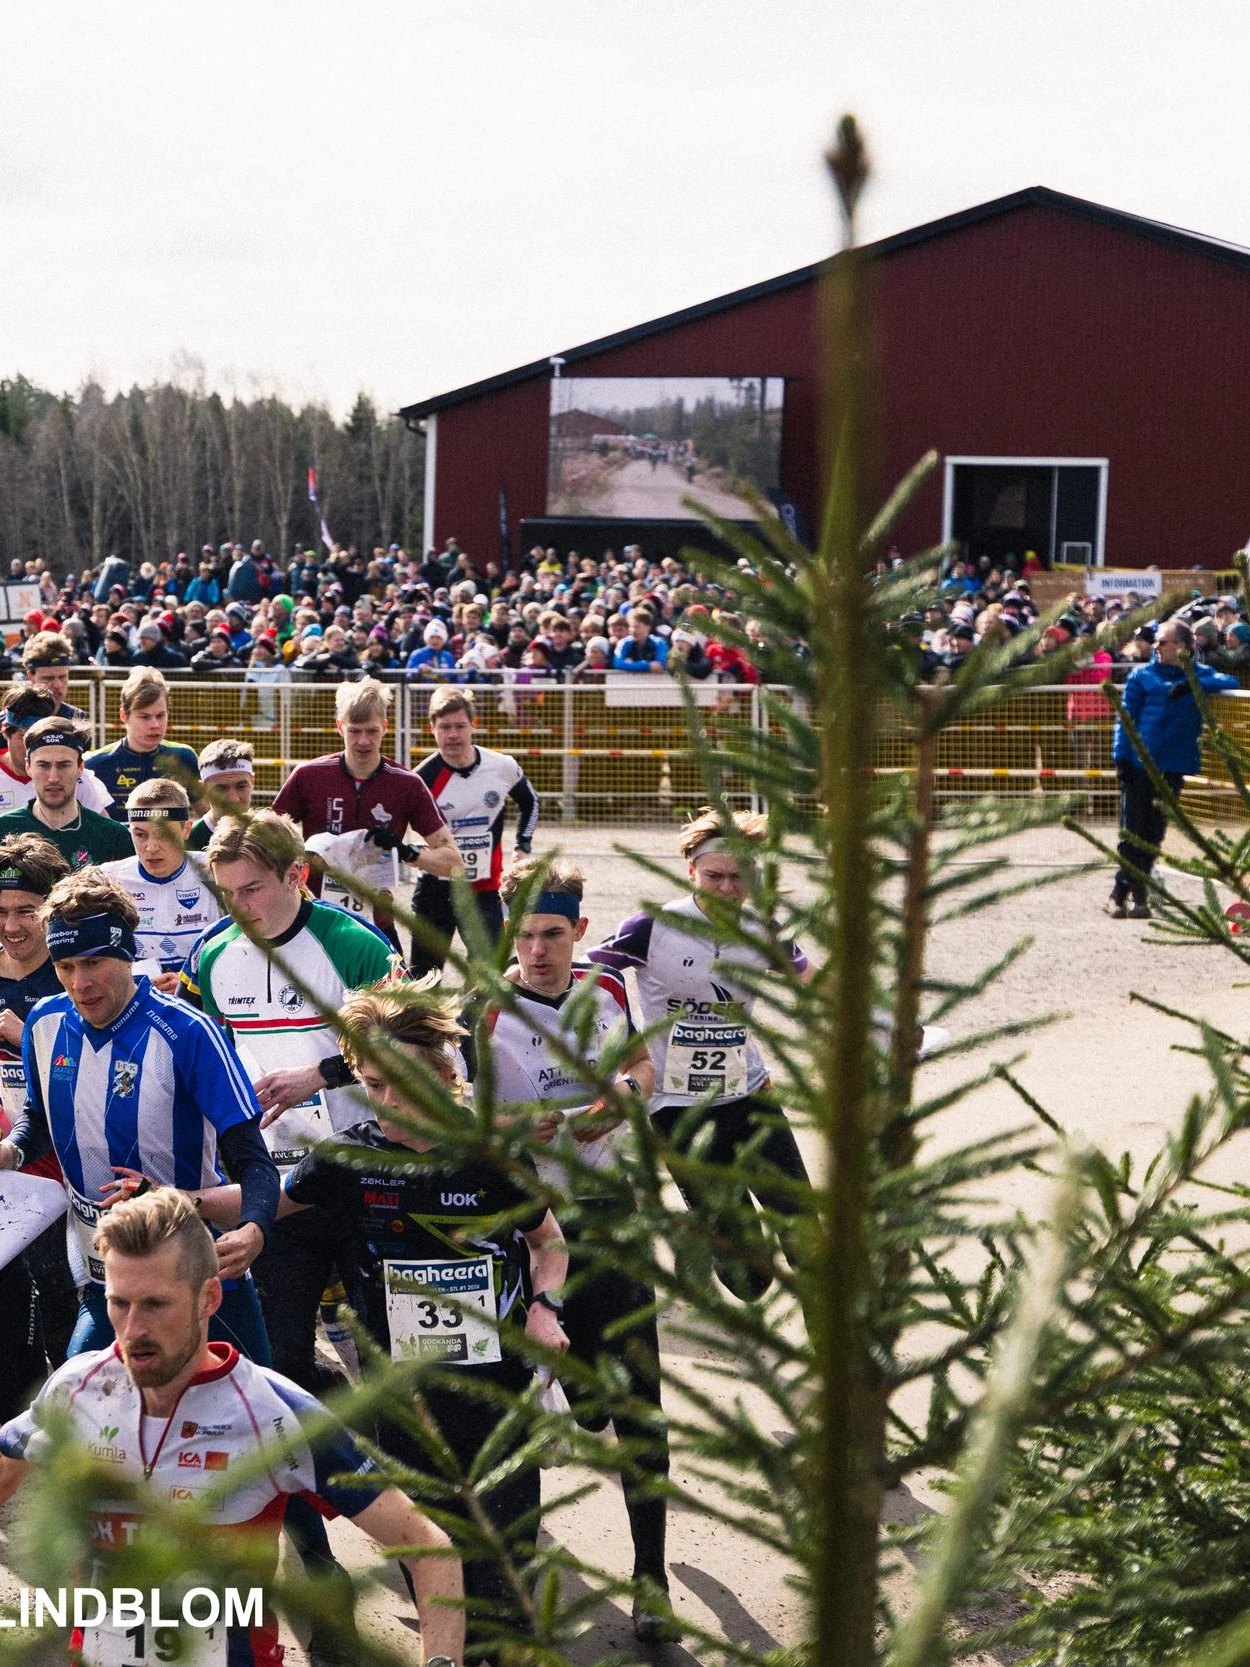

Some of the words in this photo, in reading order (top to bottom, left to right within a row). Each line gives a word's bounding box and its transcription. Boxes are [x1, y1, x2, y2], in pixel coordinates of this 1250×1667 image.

[1101, 577, 1156, 588] INFORMATION
[228, 996, 256, 1005] TRIMTEX
[110, 1001, 140, 1033] noname
[146, 1010, 179, 1041] noname
[674, 1026, 746, 1041] bagheera
[690, 1050, 727, 1070] 52
[314, 1109, 321, 1120] 1
[360, 1177, 406, 1187] ZEKLER
[440, 1192, 479, 1207] UOK
[389, 1264, 488, 1285] bagheera
[478, 1294, 485, 1307] 1
[417, 1300, 464, 1329] 33
[88, 1441, 127, 1460] Kumla
[178, 1451, 202, 1464] ICA
[172, 1488, 192, 1500] ICA
[124, 1626, 182, 1662] 19
